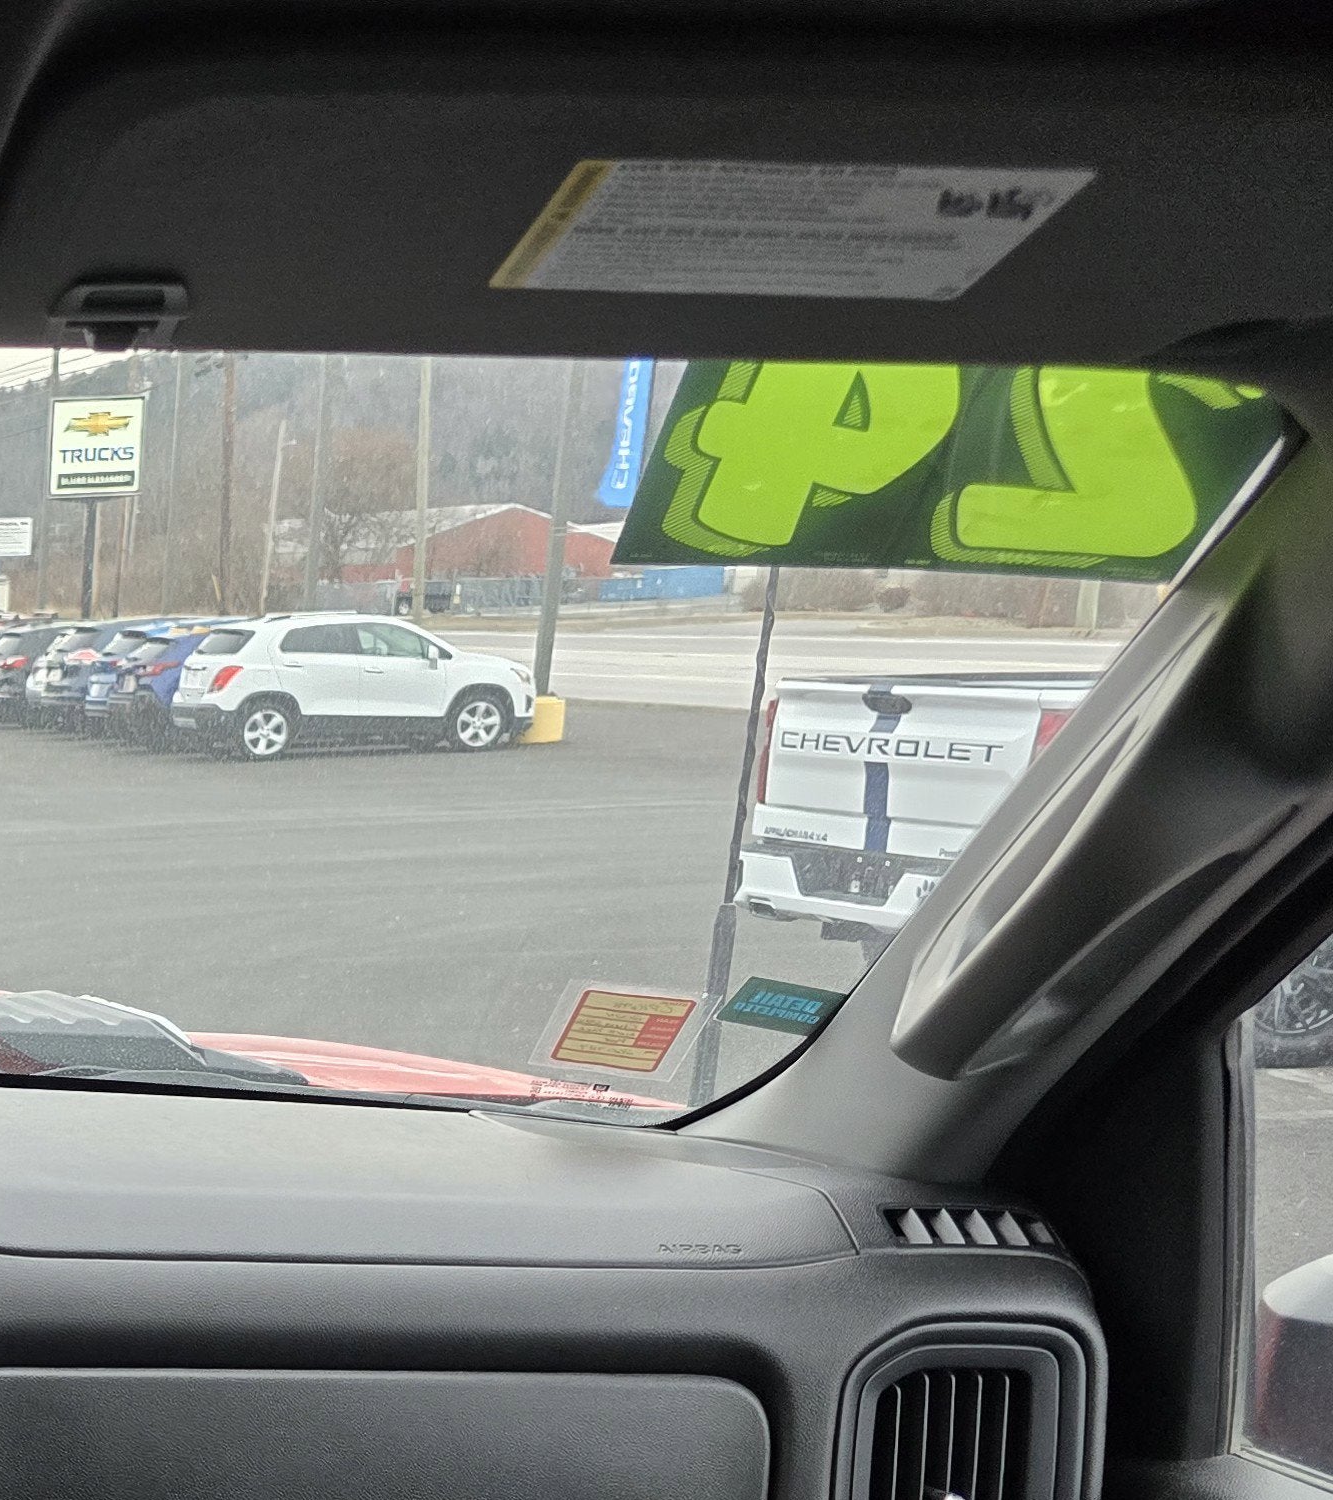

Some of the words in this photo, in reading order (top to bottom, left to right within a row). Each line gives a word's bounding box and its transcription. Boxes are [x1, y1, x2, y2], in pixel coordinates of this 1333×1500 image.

[59, 446, 135, 464] TRUCKS
[779, 729, 1005, 765] CHEVROLET
[656, 1243, 742, 1255] AIRBAG
